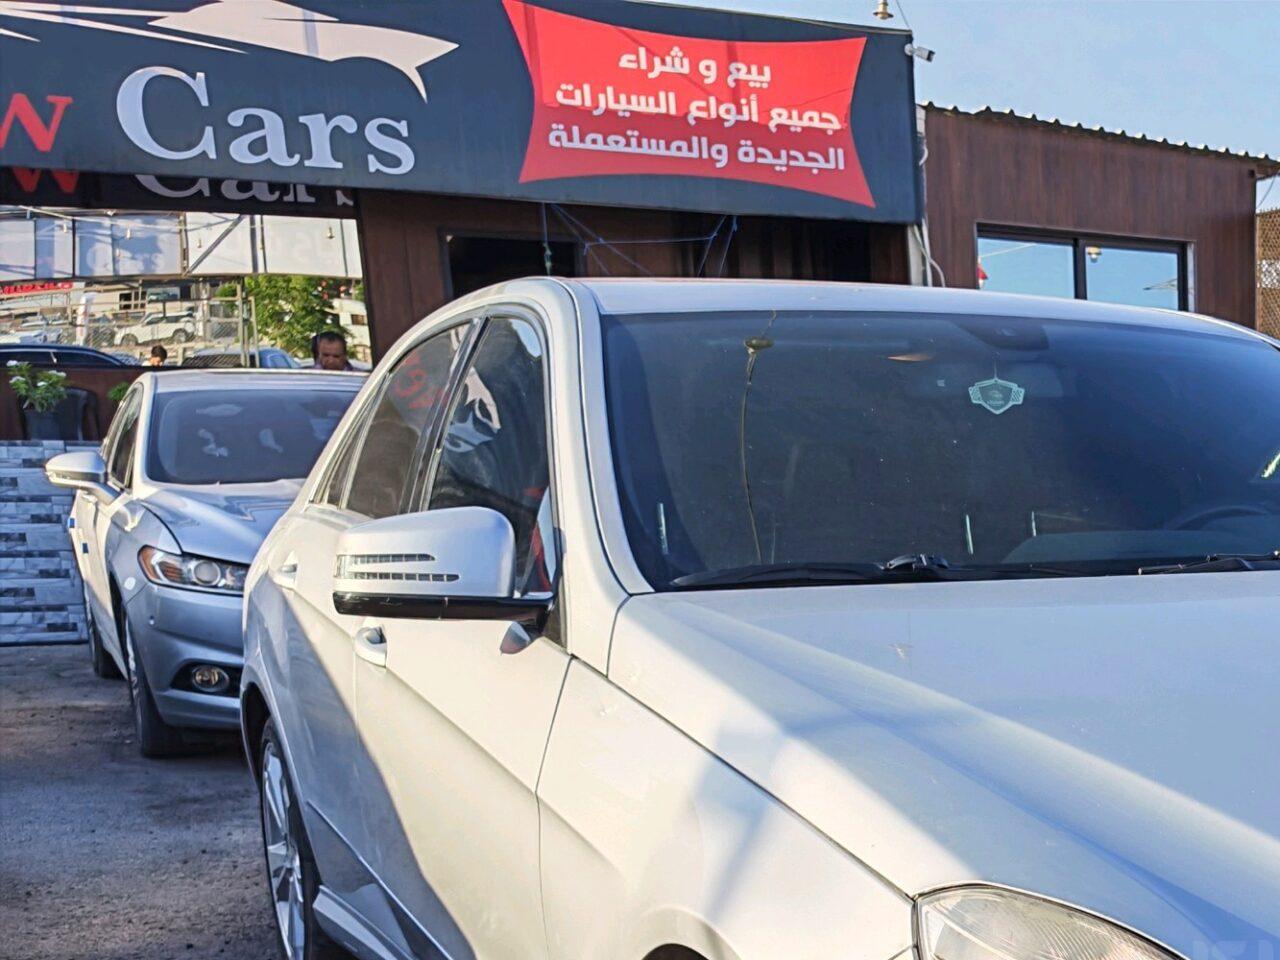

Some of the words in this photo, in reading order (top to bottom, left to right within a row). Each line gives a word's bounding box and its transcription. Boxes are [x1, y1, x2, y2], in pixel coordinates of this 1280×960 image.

[618, 46, 691, 79] شراء
[698, 59, 718, 84] و
[726, 60, 771, 89] بيع
[555, 83, 677, 116] السيارات
[687, 94, 759, 126] أنواع
[116, 65, 416, 175] Cars
[768, 105, 842, 135] جميع
[548, 123, 729, 168] والمستعملة
[737, 139, 845, 174] الجديدة
